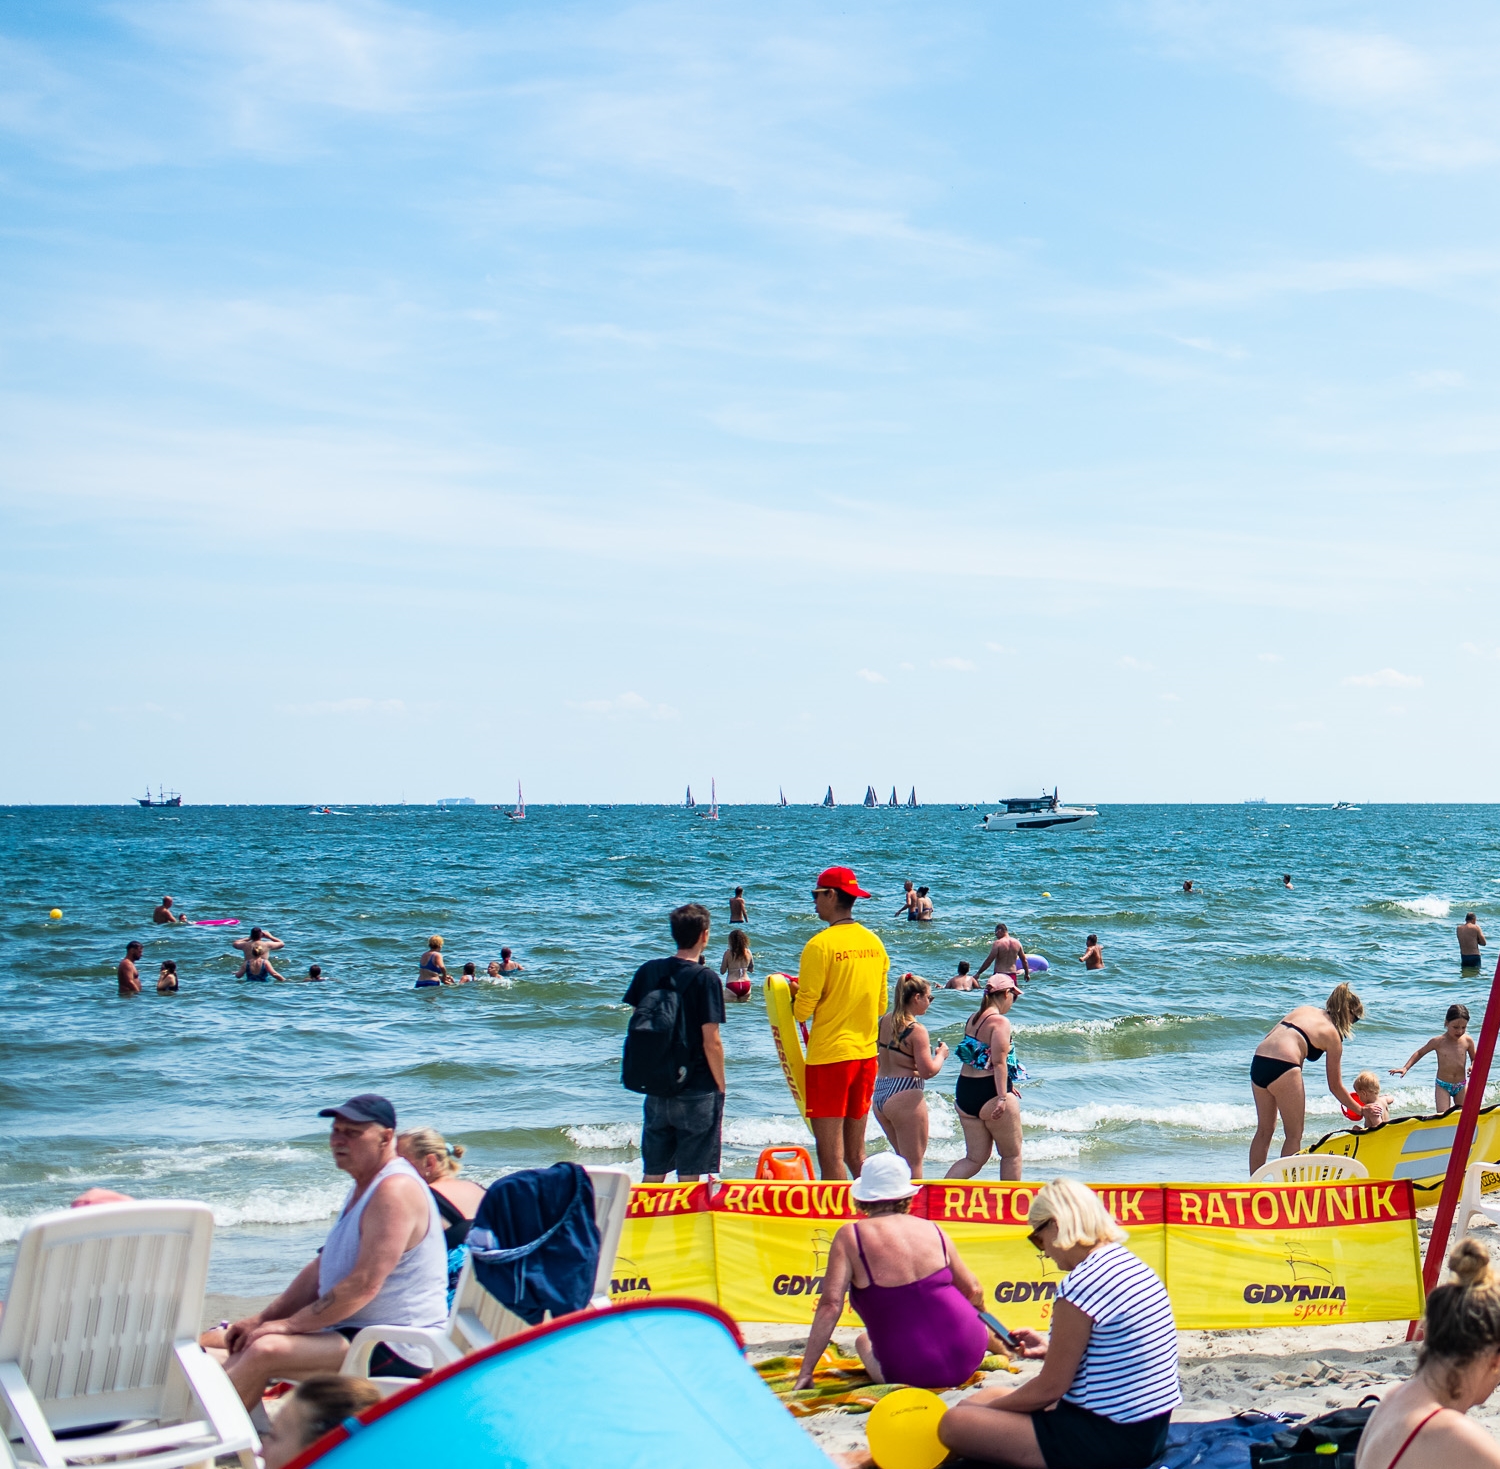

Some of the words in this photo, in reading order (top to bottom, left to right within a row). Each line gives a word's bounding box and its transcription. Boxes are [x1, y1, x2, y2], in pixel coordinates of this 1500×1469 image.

[771, 1025, 802, 1102] RESCUE
[724, 1185, 857, 1215] RATOW
[944, 1187, 1145, 1222] RATOIK
[1180, 1184, 1398, 1226] RATOWNIK
[1243, 1284, 1346, 1304] GDYNIA
[1294, 1301, 1347, 1321] sport
